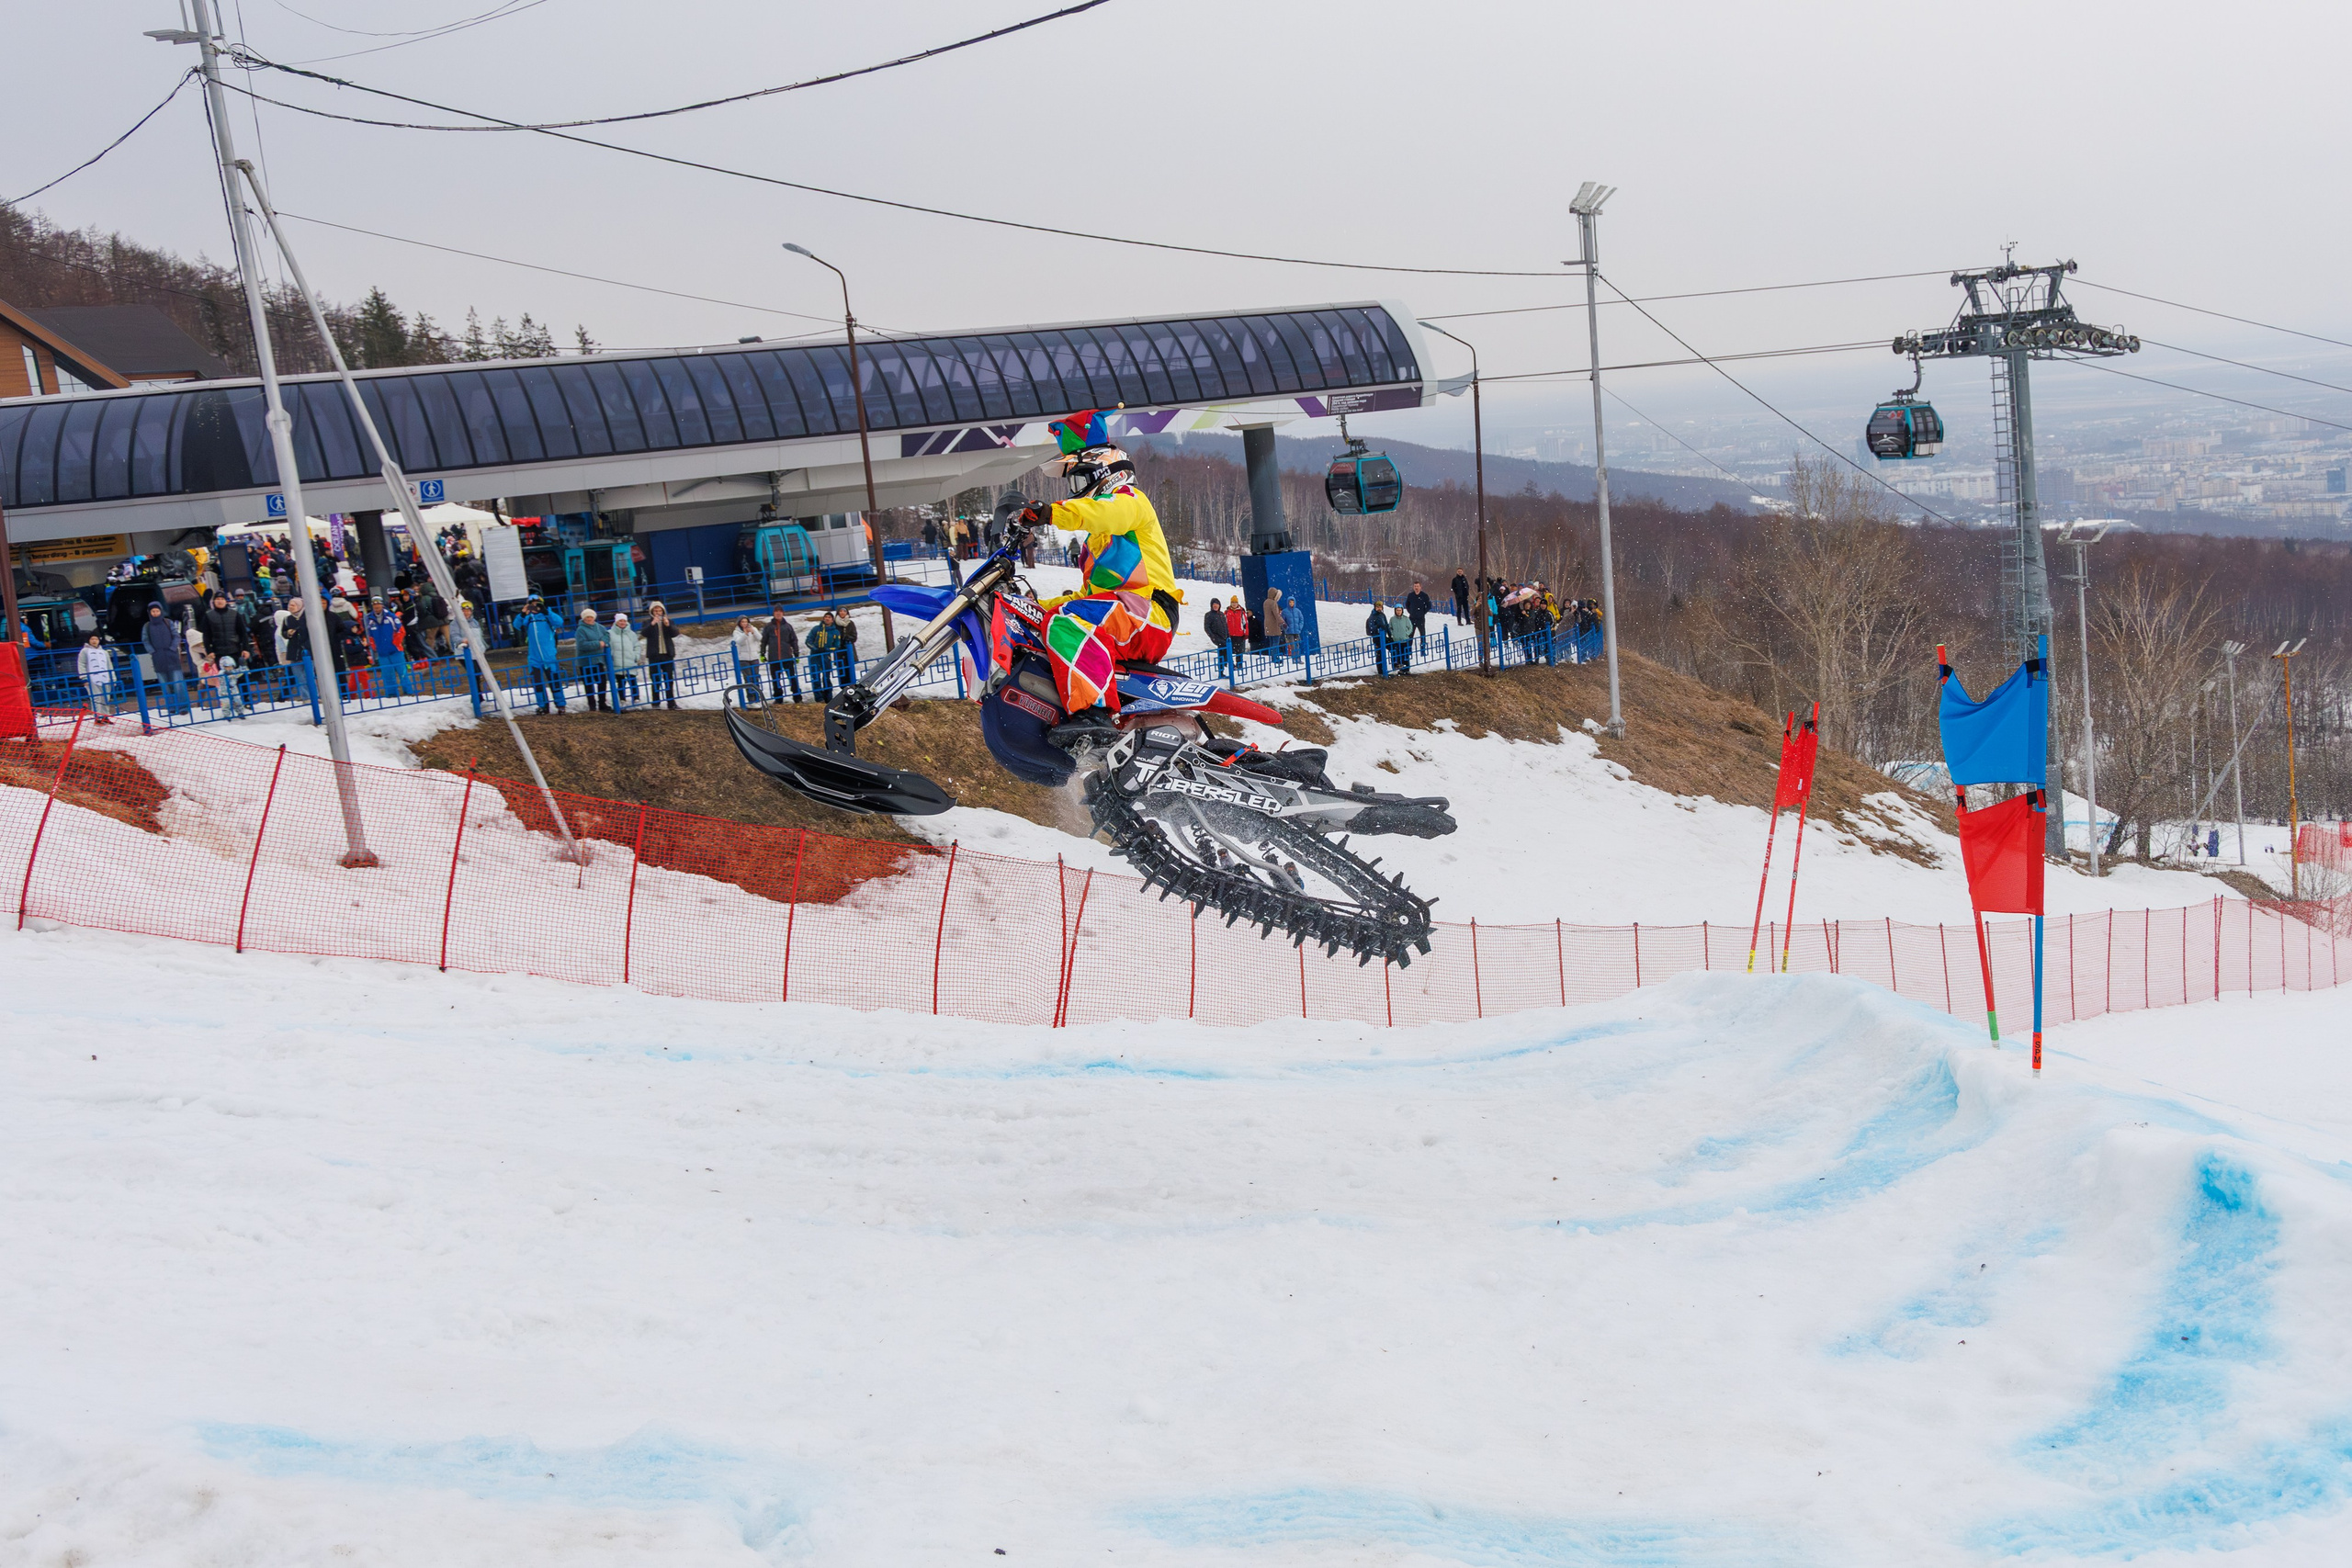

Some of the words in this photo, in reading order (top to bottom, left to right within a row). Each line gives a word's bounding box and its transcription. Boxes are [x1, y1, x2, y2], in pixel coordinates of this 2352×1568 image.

[1011, 602, 1040, 625] ENDURO
[1171, 681, 1212, 698] YETI
[1019, 695, 1053, 721] YAMAHA
[1150, 729, 1178, 740] RIOT
